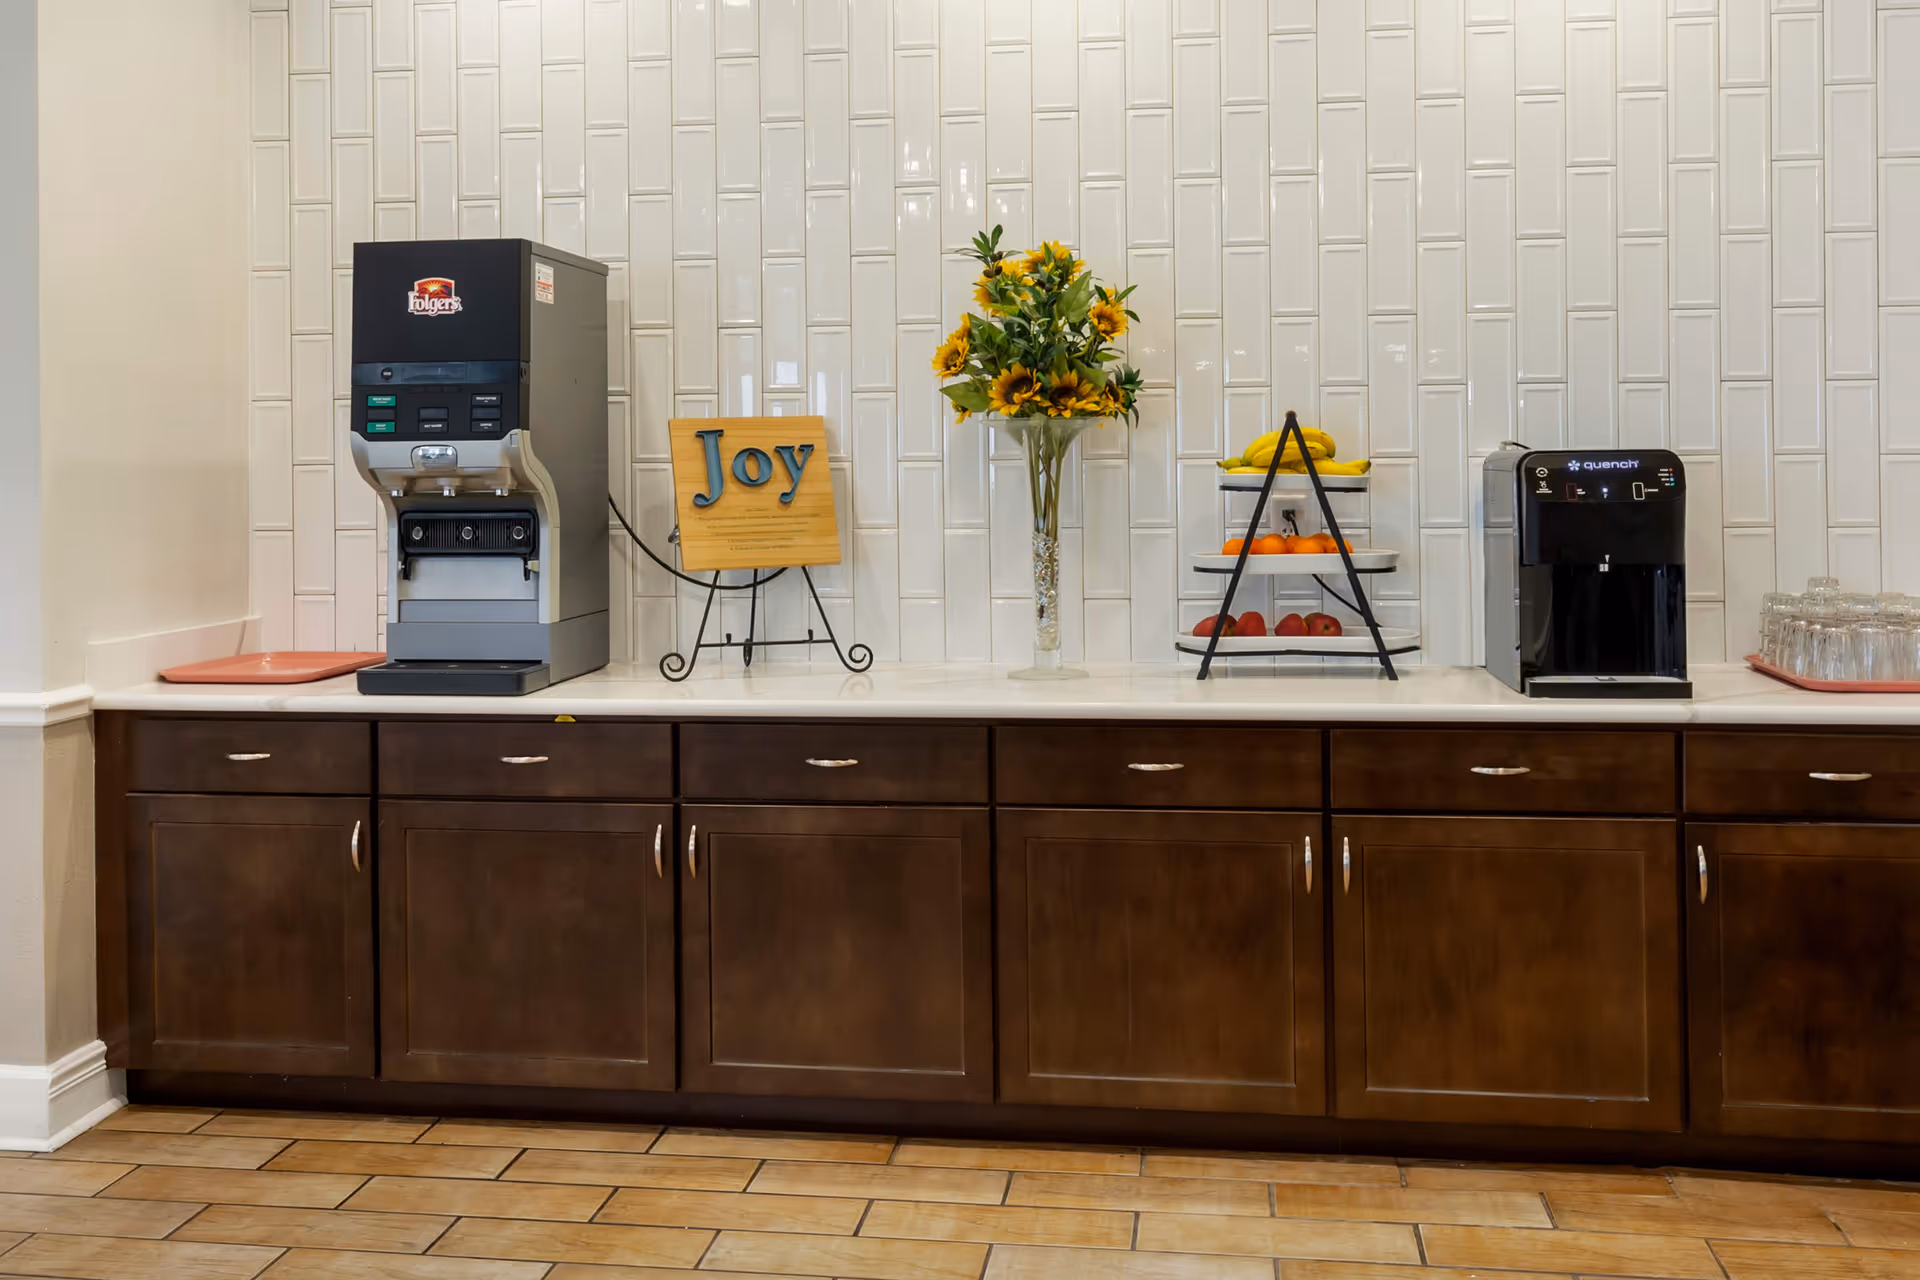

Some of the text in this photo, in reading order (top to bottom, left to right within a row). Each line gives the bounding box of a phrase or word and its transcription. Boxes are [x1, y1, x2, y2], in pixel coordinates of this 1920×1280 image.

[408, 291, 462, 316] Folgers
[693, 429, 814, 507] Joy
[1583, 459, 1638, 470] quench
